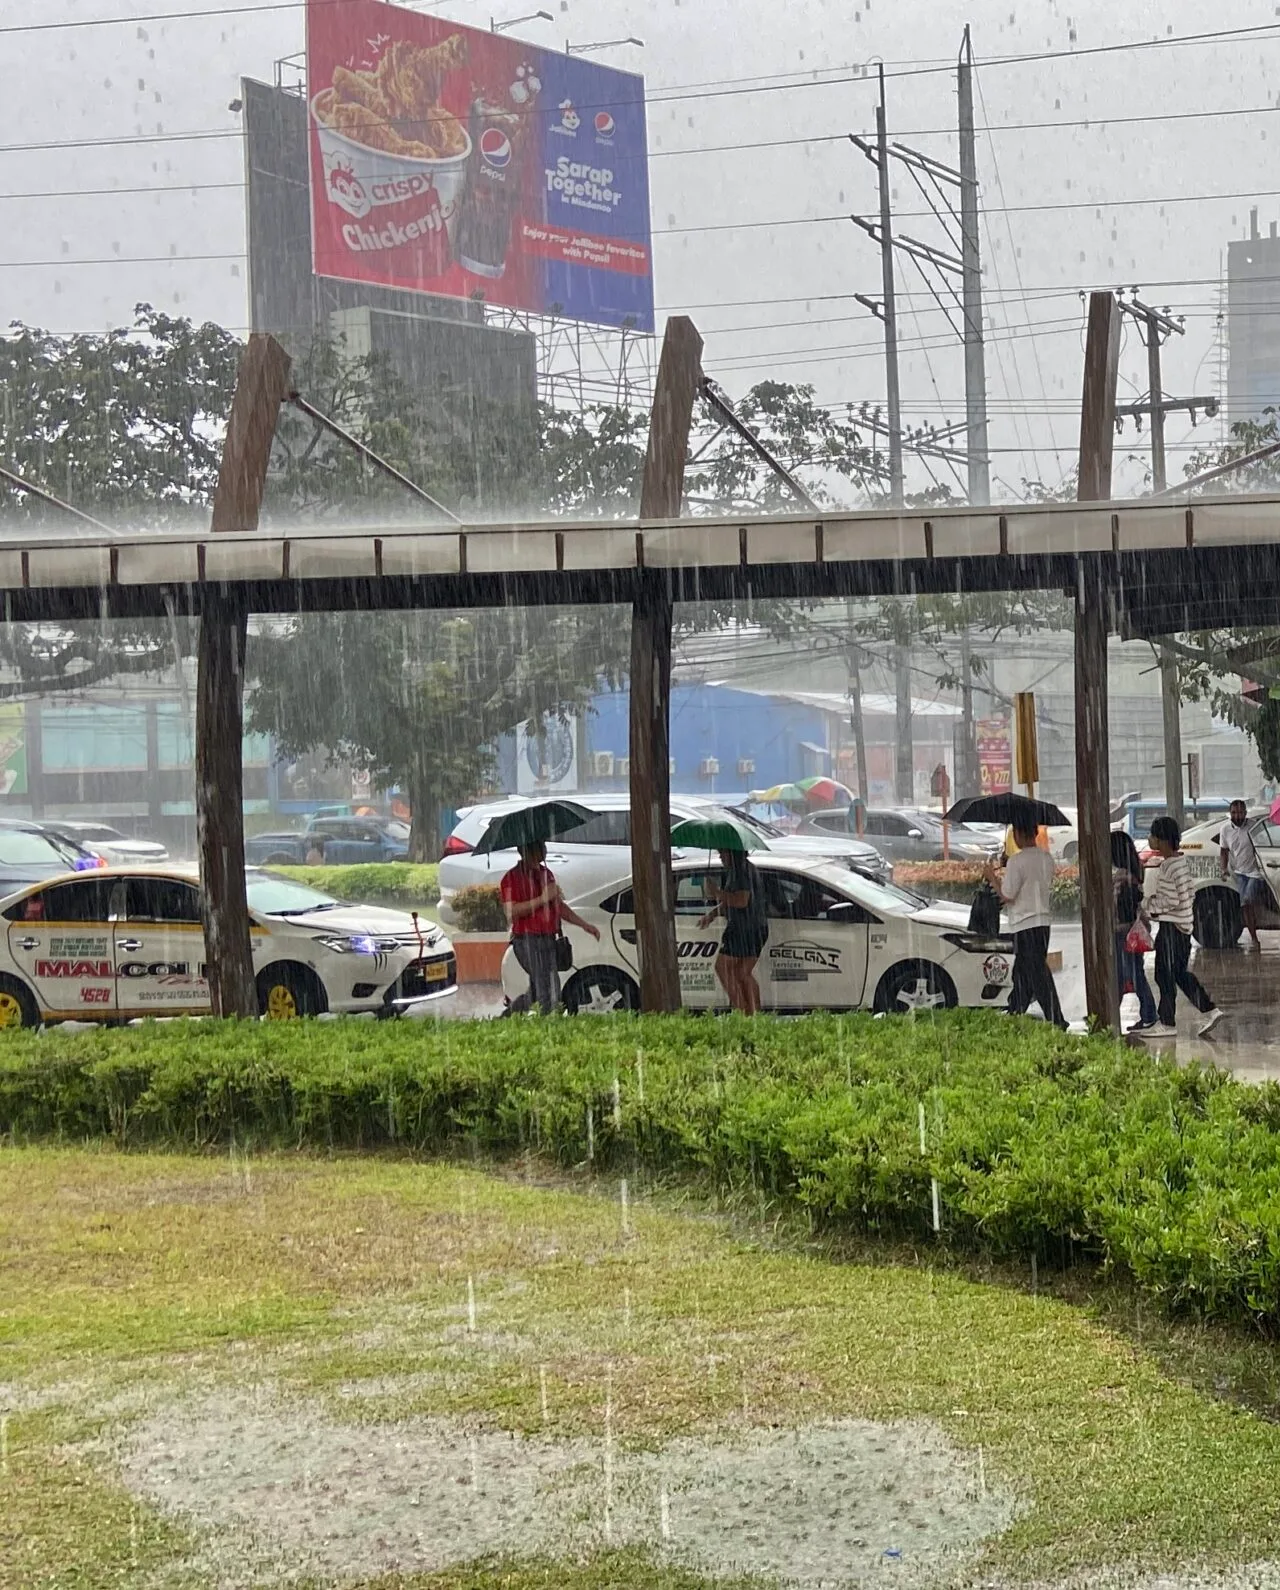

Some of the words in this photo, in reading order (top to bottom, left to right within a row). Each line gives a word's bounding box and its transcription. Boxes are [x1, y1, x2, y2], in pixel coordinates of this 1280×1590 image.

[371, 171, 434, 201] crispy
[557, 157, 614, 187] Sarap
[545, 169, 622, 206] Together
[342, 202, 456, 251] Chickenjo
[523, 225, 547, 241] Enjoy
[675, 941, 719, 958] 070
